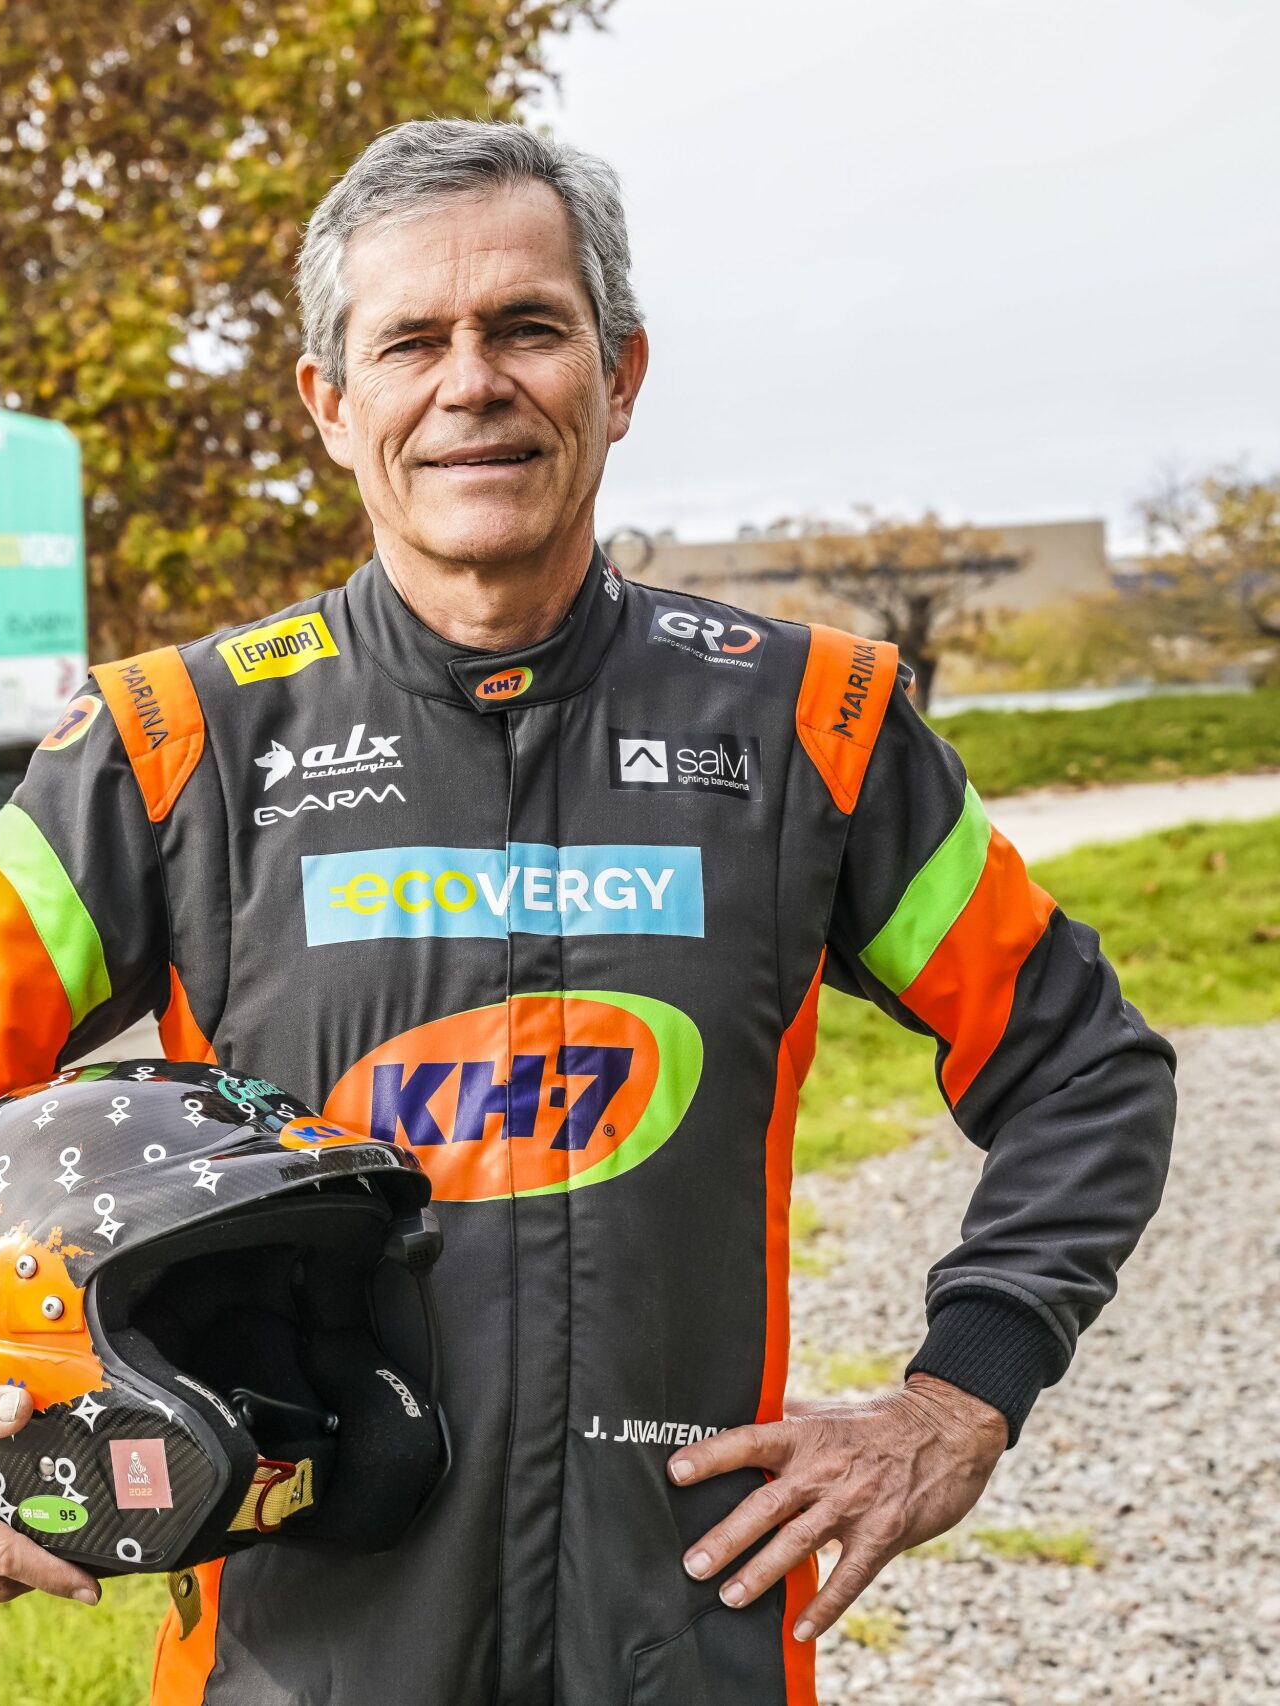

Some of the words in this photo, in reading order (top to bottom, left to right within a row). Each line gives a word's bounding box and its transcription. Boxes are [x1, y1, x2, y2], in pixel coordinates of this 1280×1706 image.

[652, 635, 705, 660] PERFORMANCE
[704, 655, 754, 669] LUBRICATION
[118, 662, 169, 750] MARINA
[831, 644, 877, 739] MARINA
[301, 723, 402, 768] alx
[302, 758, 404, 780] technologies
[675, 743, 749, 781] salvi
[677, 774, 710, 786] lighting
[710, 778, 750, 791] barcelona
[253, 783, 406, 826] EVARM
[584, 1415, 607, 1439] J.
[127, 1473, 151, 1485] DAKAR
[128, 1487, 153, 1497] 2022
[59, 1509, 77, 1521] 95
